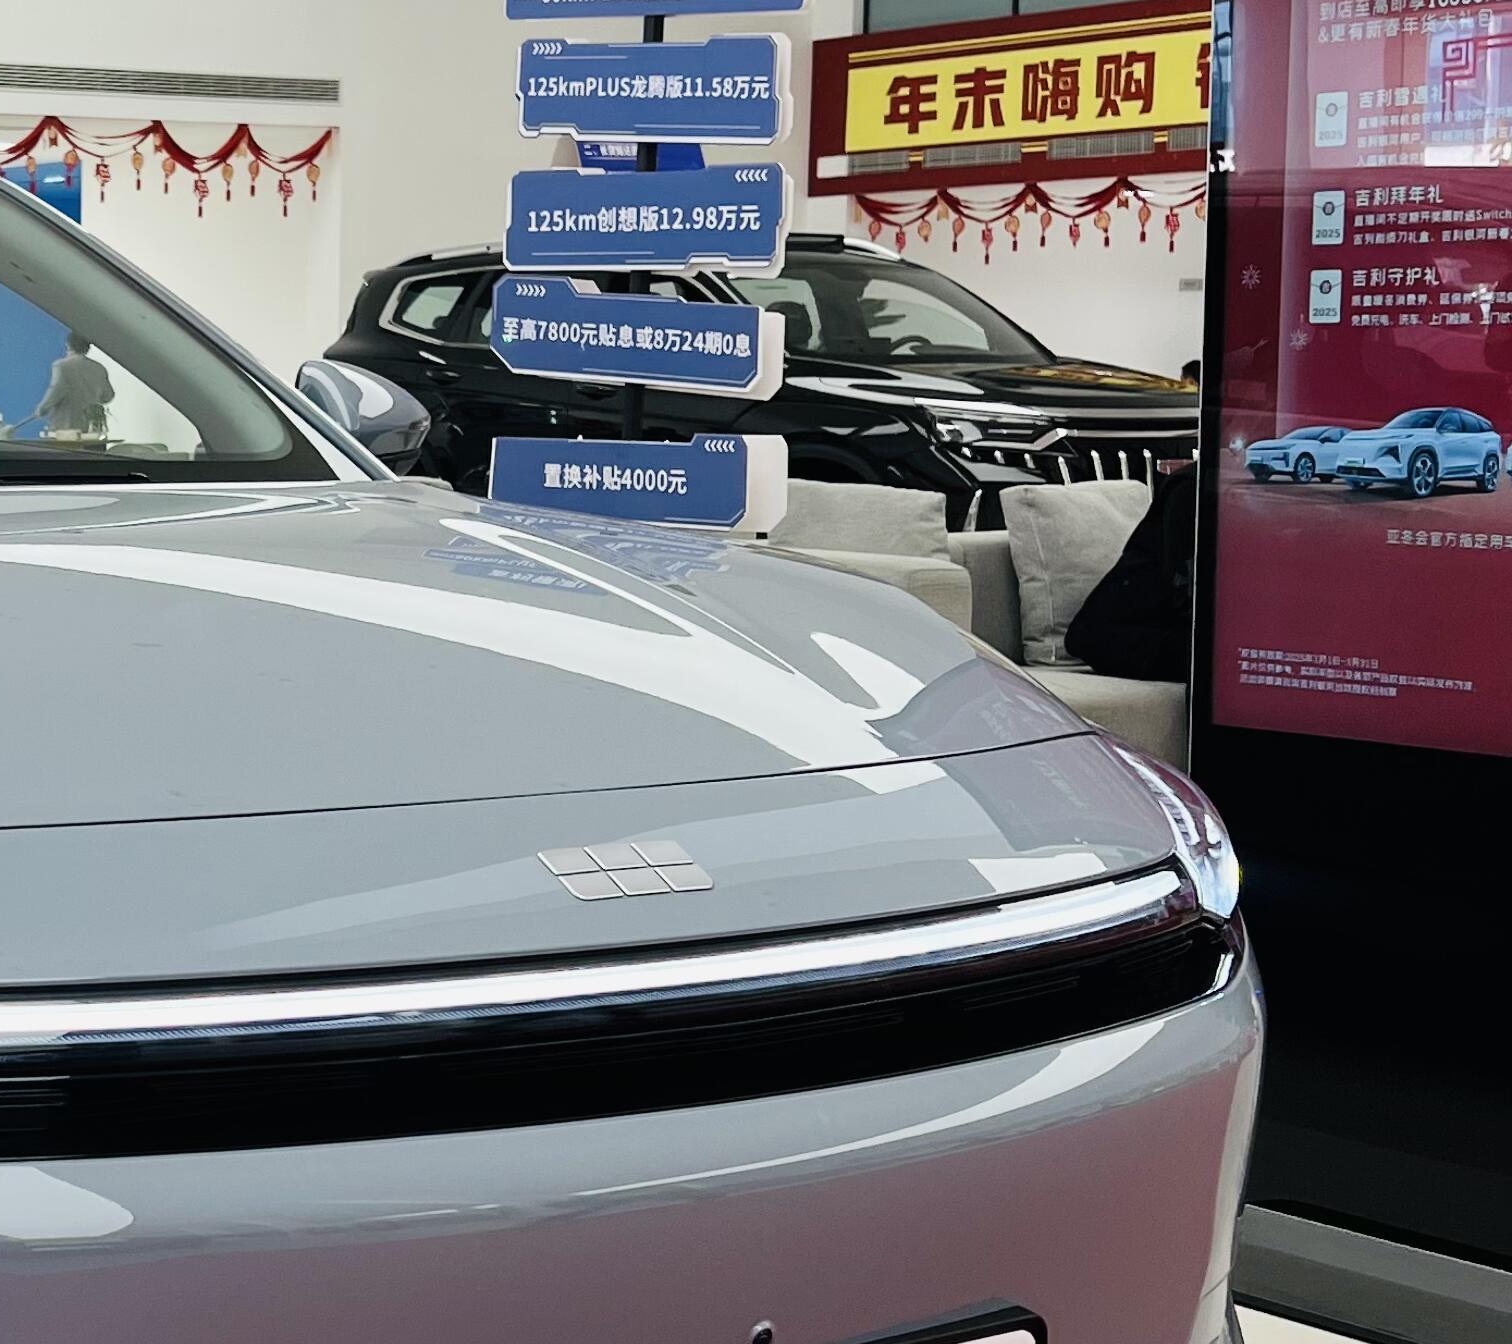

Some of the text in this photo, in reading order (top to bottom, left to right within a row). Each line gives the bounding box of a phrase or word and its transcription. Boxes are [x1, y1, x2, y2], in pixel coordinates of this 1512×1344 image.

[527, 74, 771, 101] 125kmPLUS龙腾版11.58万元
[883, 50, 1157, 135] 年末嗨购
[1354, 183, 1445, 207] 吉利拜年礼
[527, 205, 761, 234] 125km创想版12.98万元
[1315, 228, 1341, 239] 2025
[1351, 266, 1440, 287] 吉利守护礼
[1311, 307, 1338, 318] 2025
[502, 315, 752, 359] 至高7800元贴息或8万24期0息
[543, 462, 688, 495] 置换补贴4000元
